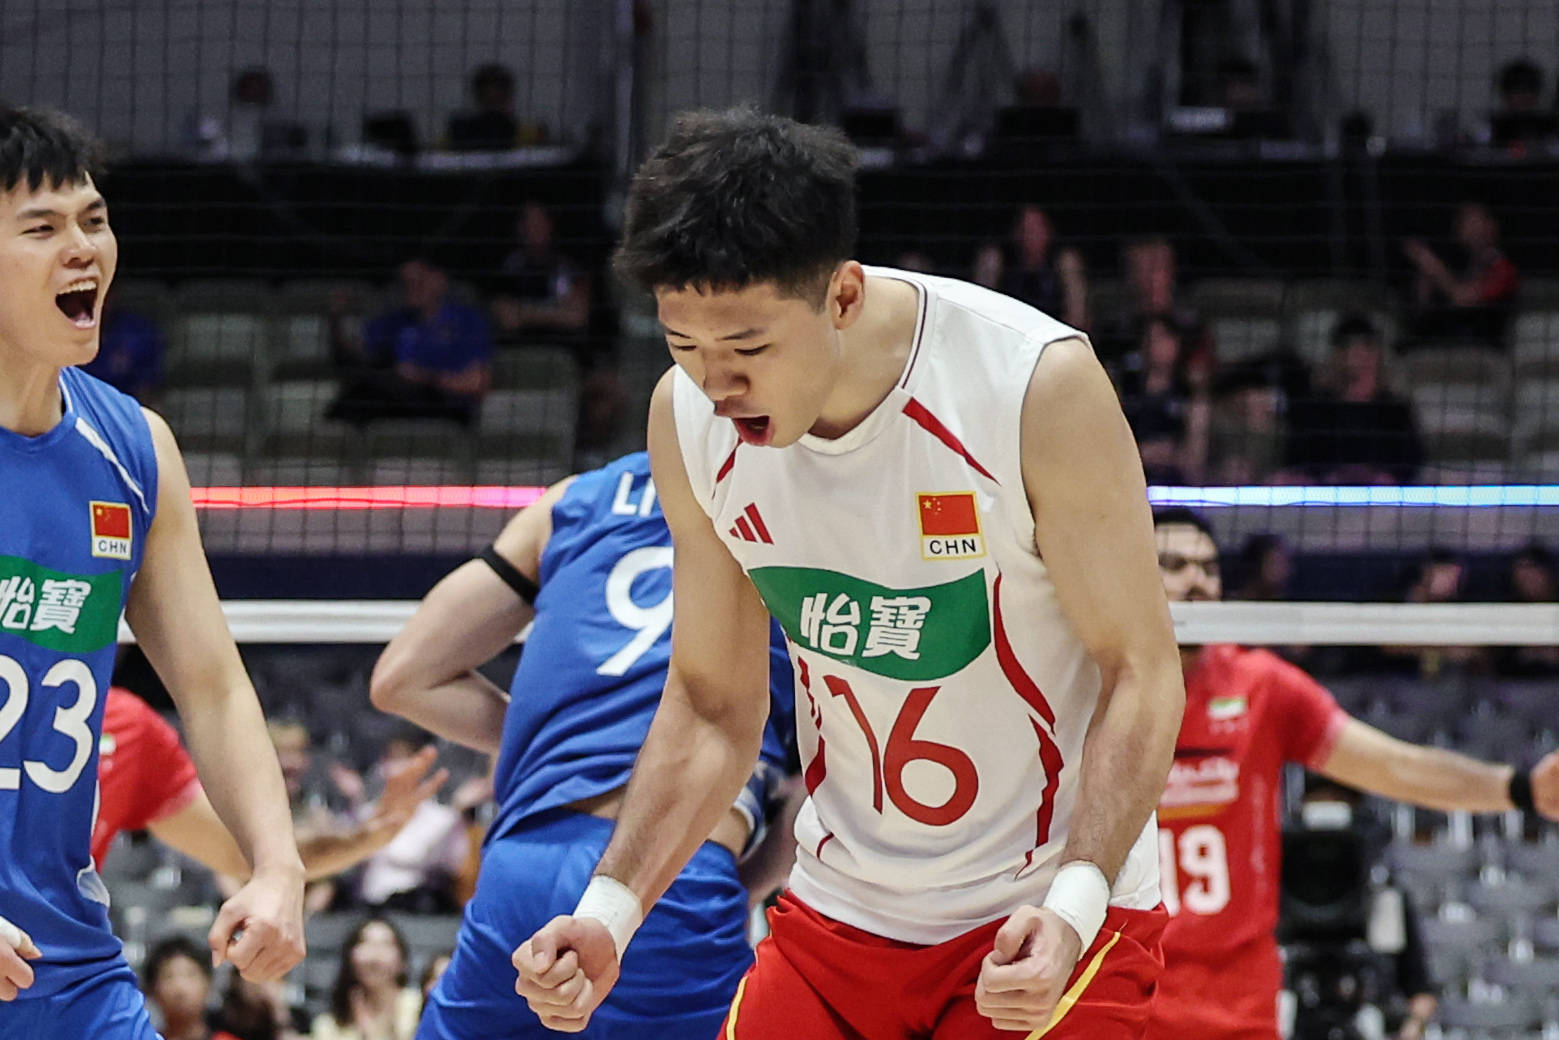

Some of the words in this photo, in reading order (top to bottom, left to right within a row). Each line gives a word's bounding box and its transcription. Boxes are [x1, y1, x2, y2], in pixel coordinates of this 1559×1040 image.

[98, 539, 127, 553] CHN
[929, 538, 977, 555] CHN
[596, 545, 675, 678] 9
[799, 591, 933, 661] 怡寶
[823, 674, 979, 826] 16
[1158, 823, 1232, 918] 19
